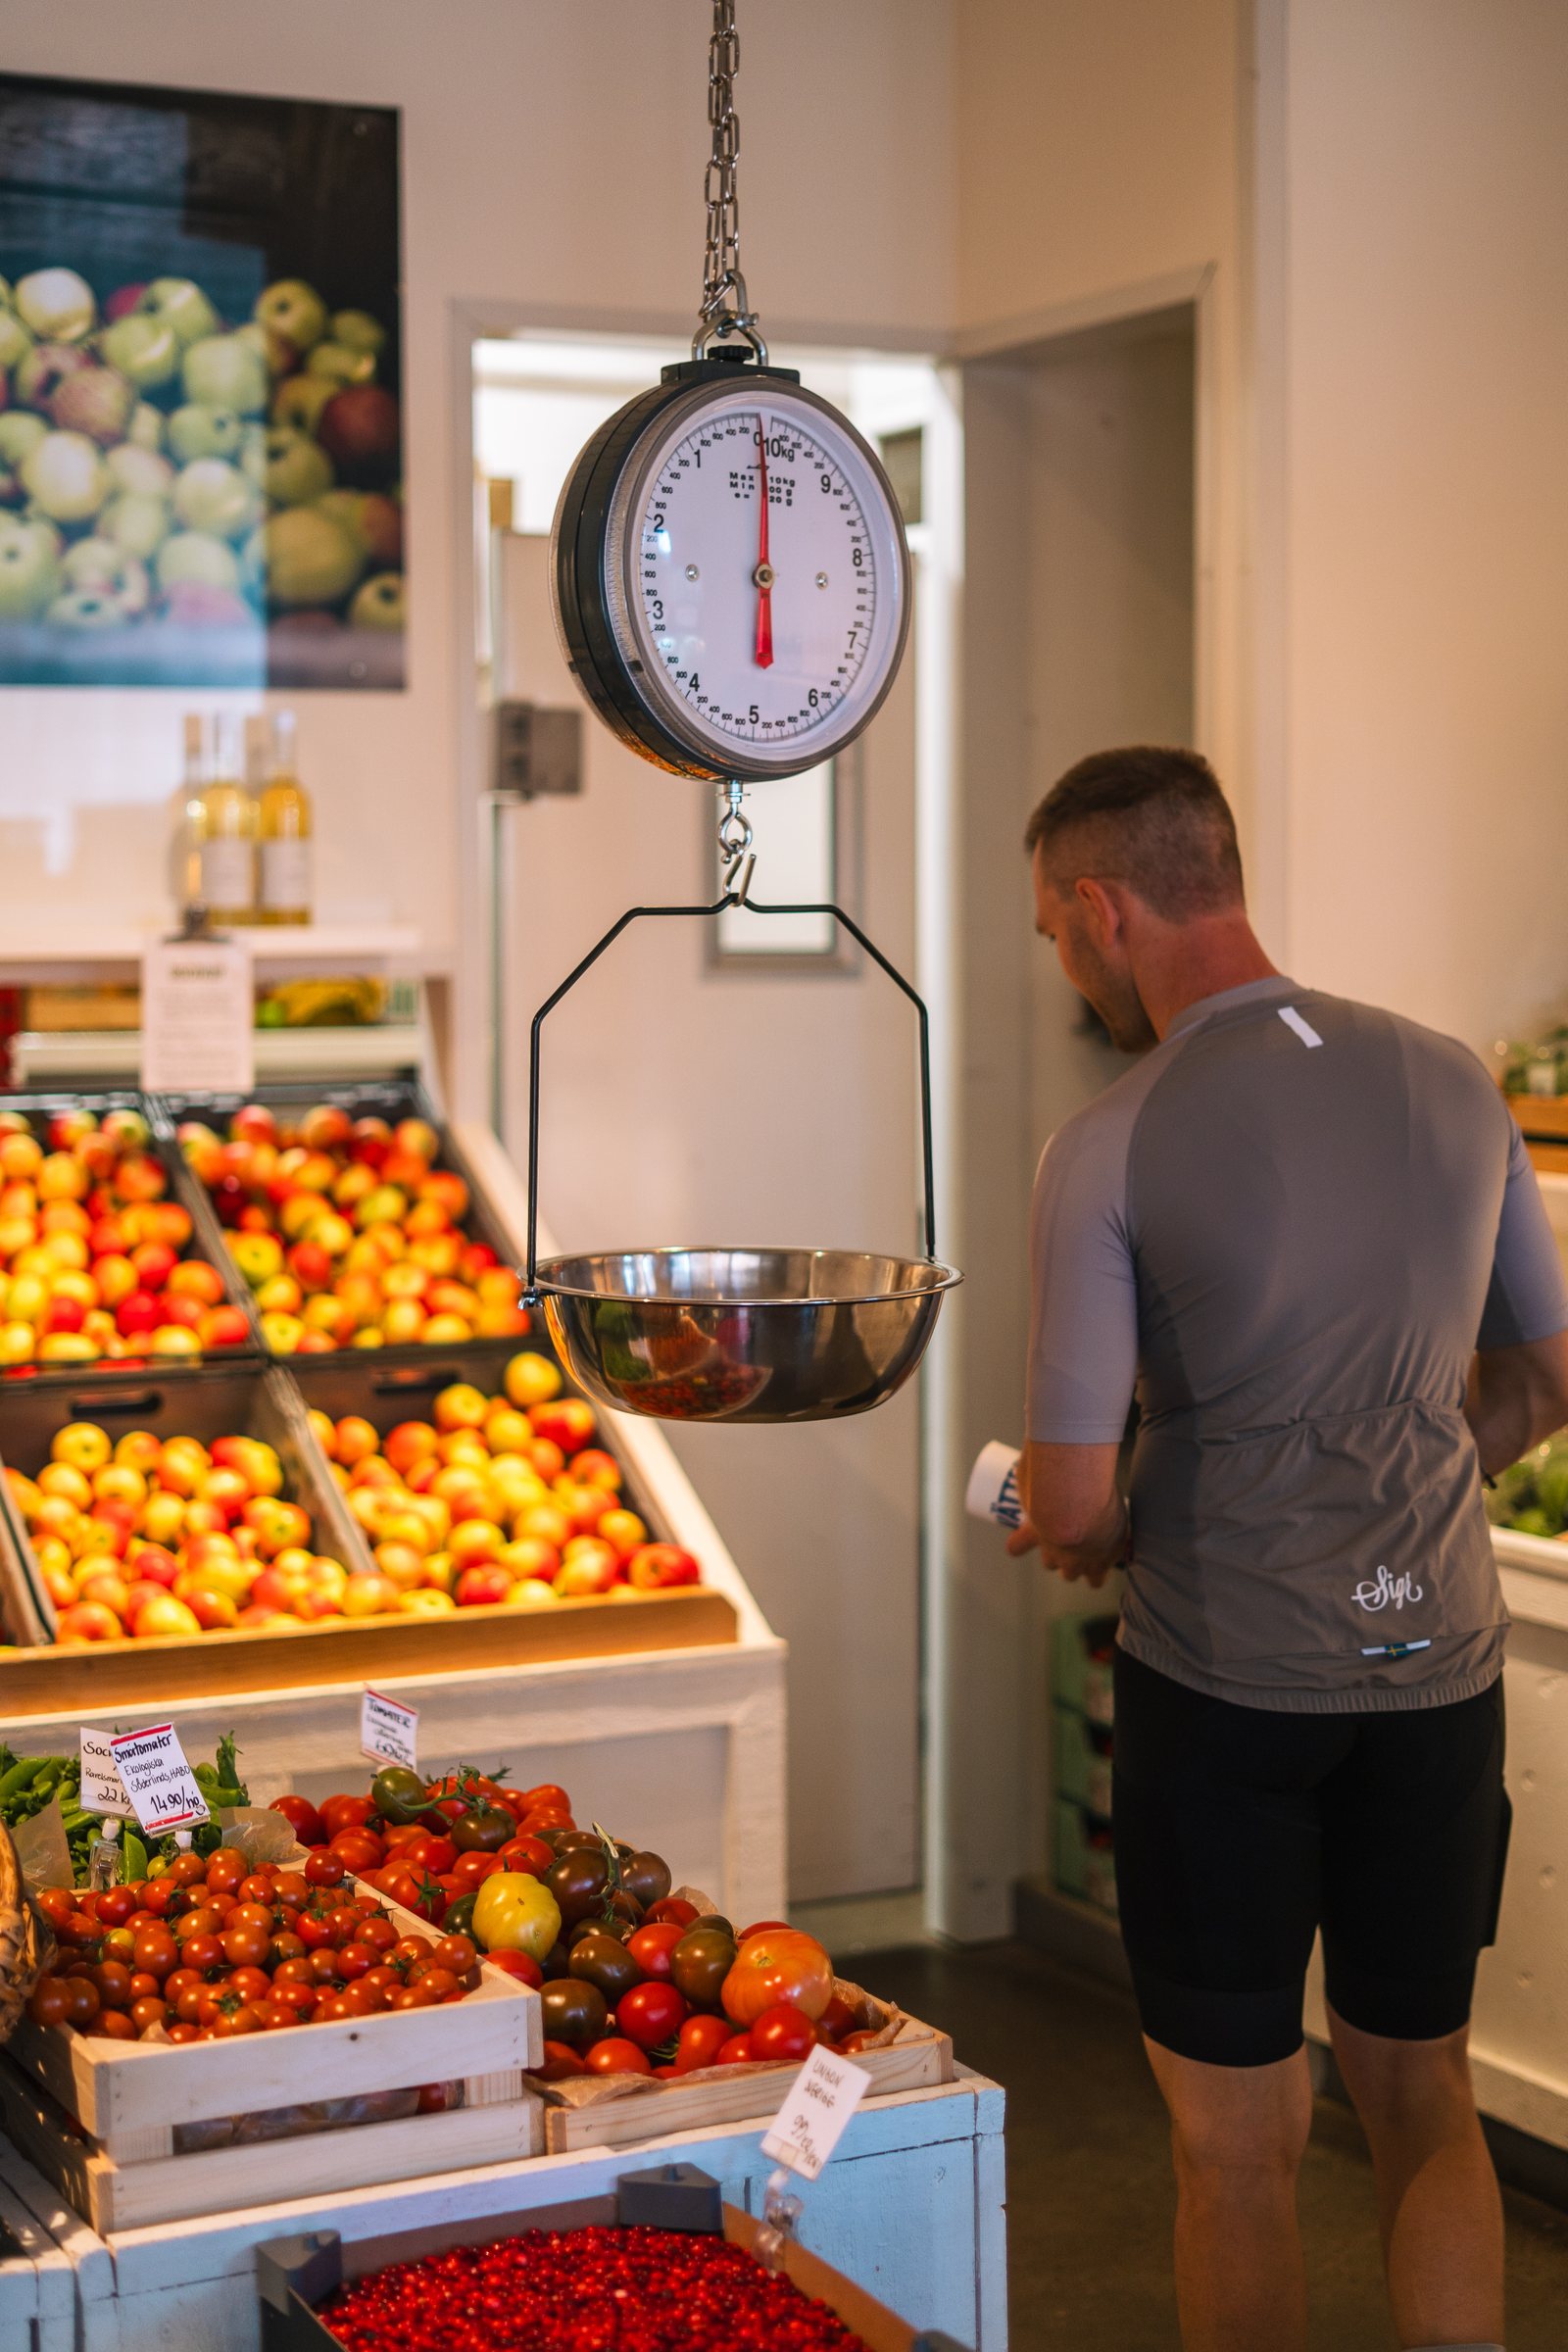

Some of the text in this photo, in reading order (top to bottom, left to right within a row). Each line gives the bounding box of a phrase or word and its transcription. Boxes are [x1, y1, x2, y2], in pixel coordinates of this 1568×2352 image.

[725, 426, 736, 436] 400
[753, 431, 762, 446] 0
[700, 439, 711, 448] 800
[763, 437, 795, 462] 10kg
[678, 459, 690, 467] 200
[693, 449, 701, 468] 1
[669, 471, 681, 480] 400
[729, 472, 795, 487] Max 10kg
[820, 474, 831, 493] 9
[729, 481, 755, 490] Min
[656, 501, 666, 510] 800
[769, 495, 782, 504] 20
[786, 498, 792, 507] g
[654, 514, 664, 533] 2
[853, 548, 862, 566] 8
[653, 600, 663, 619] 3
[848, 631, 858, 649] 7
[689, 672, 700, 692] 4
[808, 688, 818, 708] 6
[749, 705, 760, 724] 5
[124, 1757, 164, 1776] Ekologiska
[98, 1787, 117, 1802] 22
